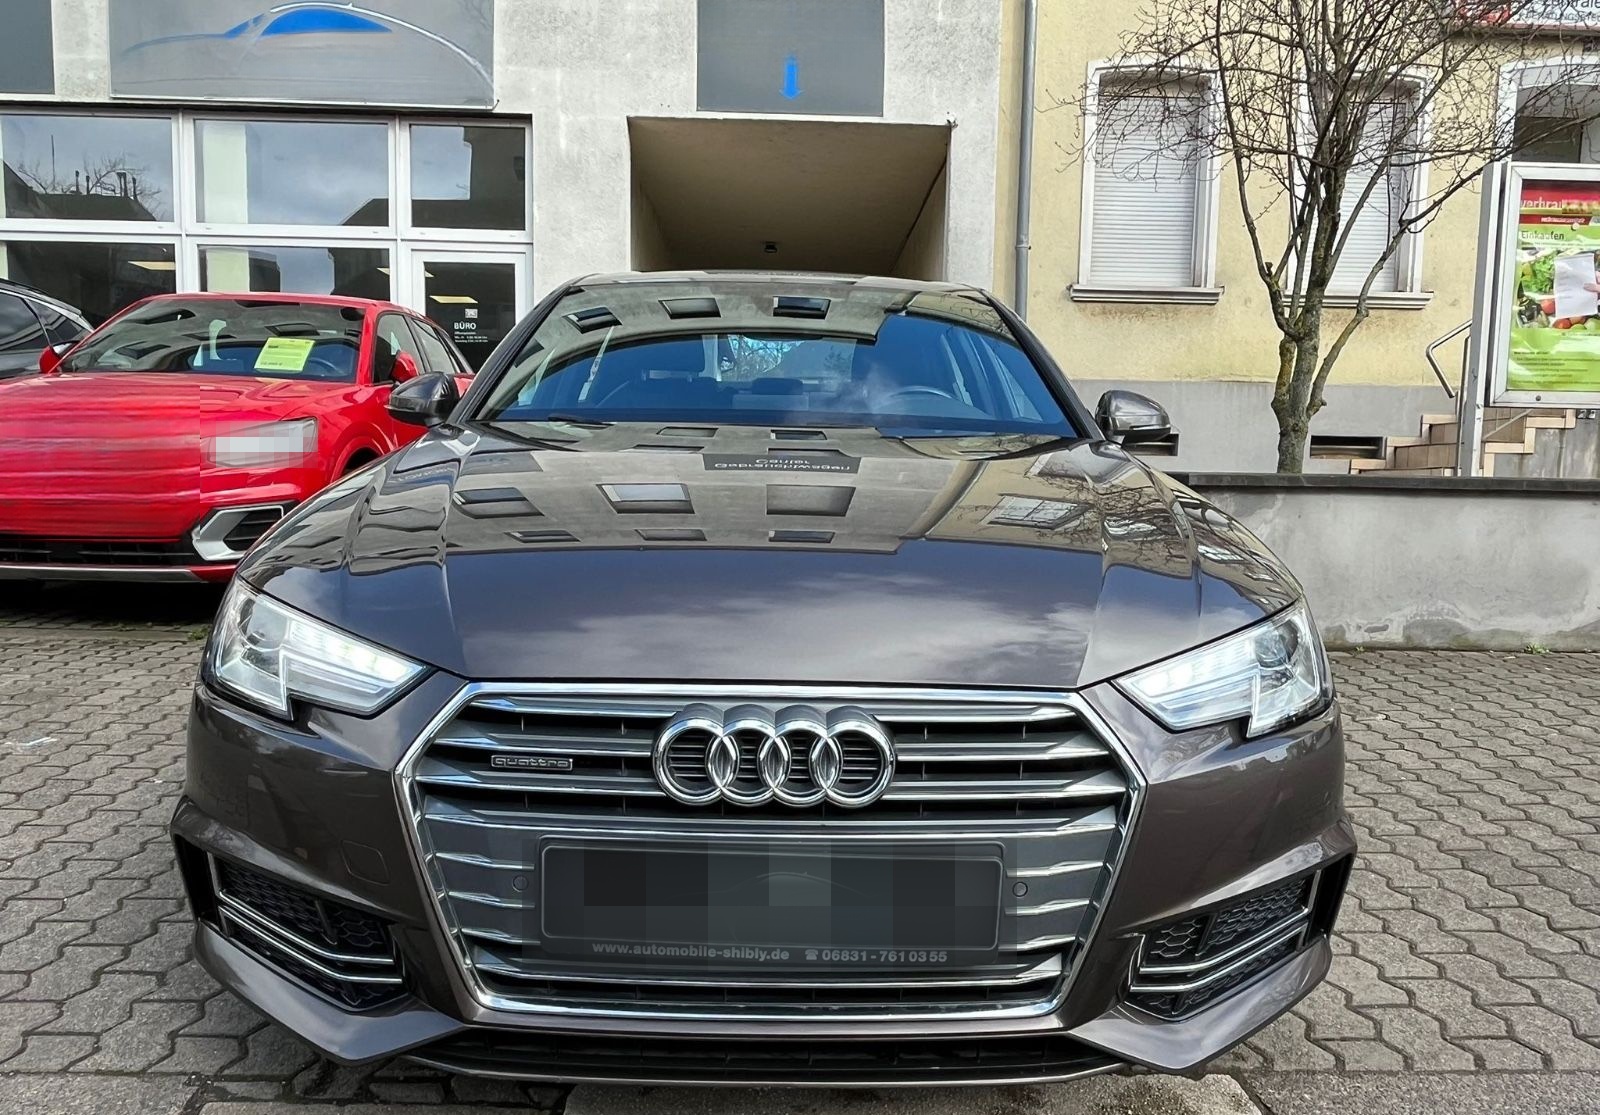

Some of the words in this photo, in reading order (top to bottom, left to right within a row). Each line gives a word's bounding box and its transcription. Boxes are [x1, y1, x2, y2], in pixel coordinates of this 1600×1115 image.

[453, 321, 477, 330] BÜRO
[493, 757, 570, 768] quattro
[591, 942, 790, 962] www.automobile-shibly.de
[821, 949, 867, 961] 06831
